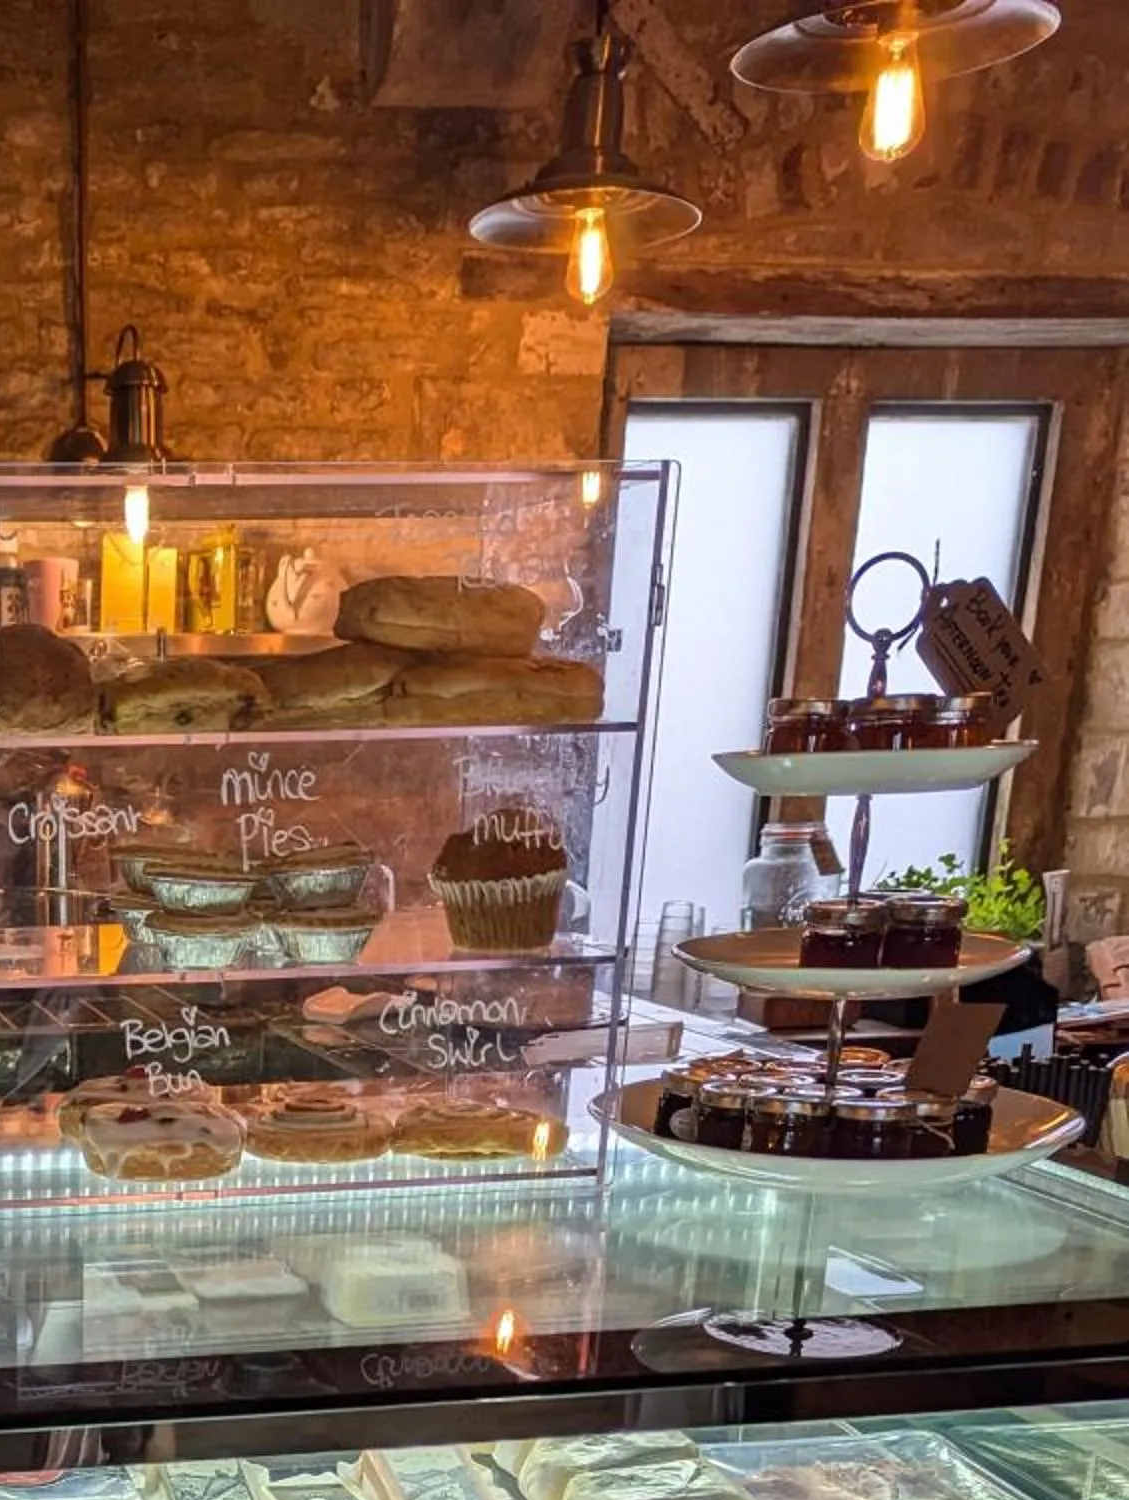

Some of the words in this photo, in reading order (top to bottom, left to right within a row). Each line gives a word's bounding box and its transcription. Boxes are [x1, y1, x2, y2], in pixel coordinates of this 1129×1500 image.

[236, 807, 312, 871] Pies
[120, 1006, 232, 1063] Belgian
[378, 990, 527, 1036] Cinnamon
[428, 1028, 516, 1070] Swirl
[146, 1062, 203, 1098] Bun
